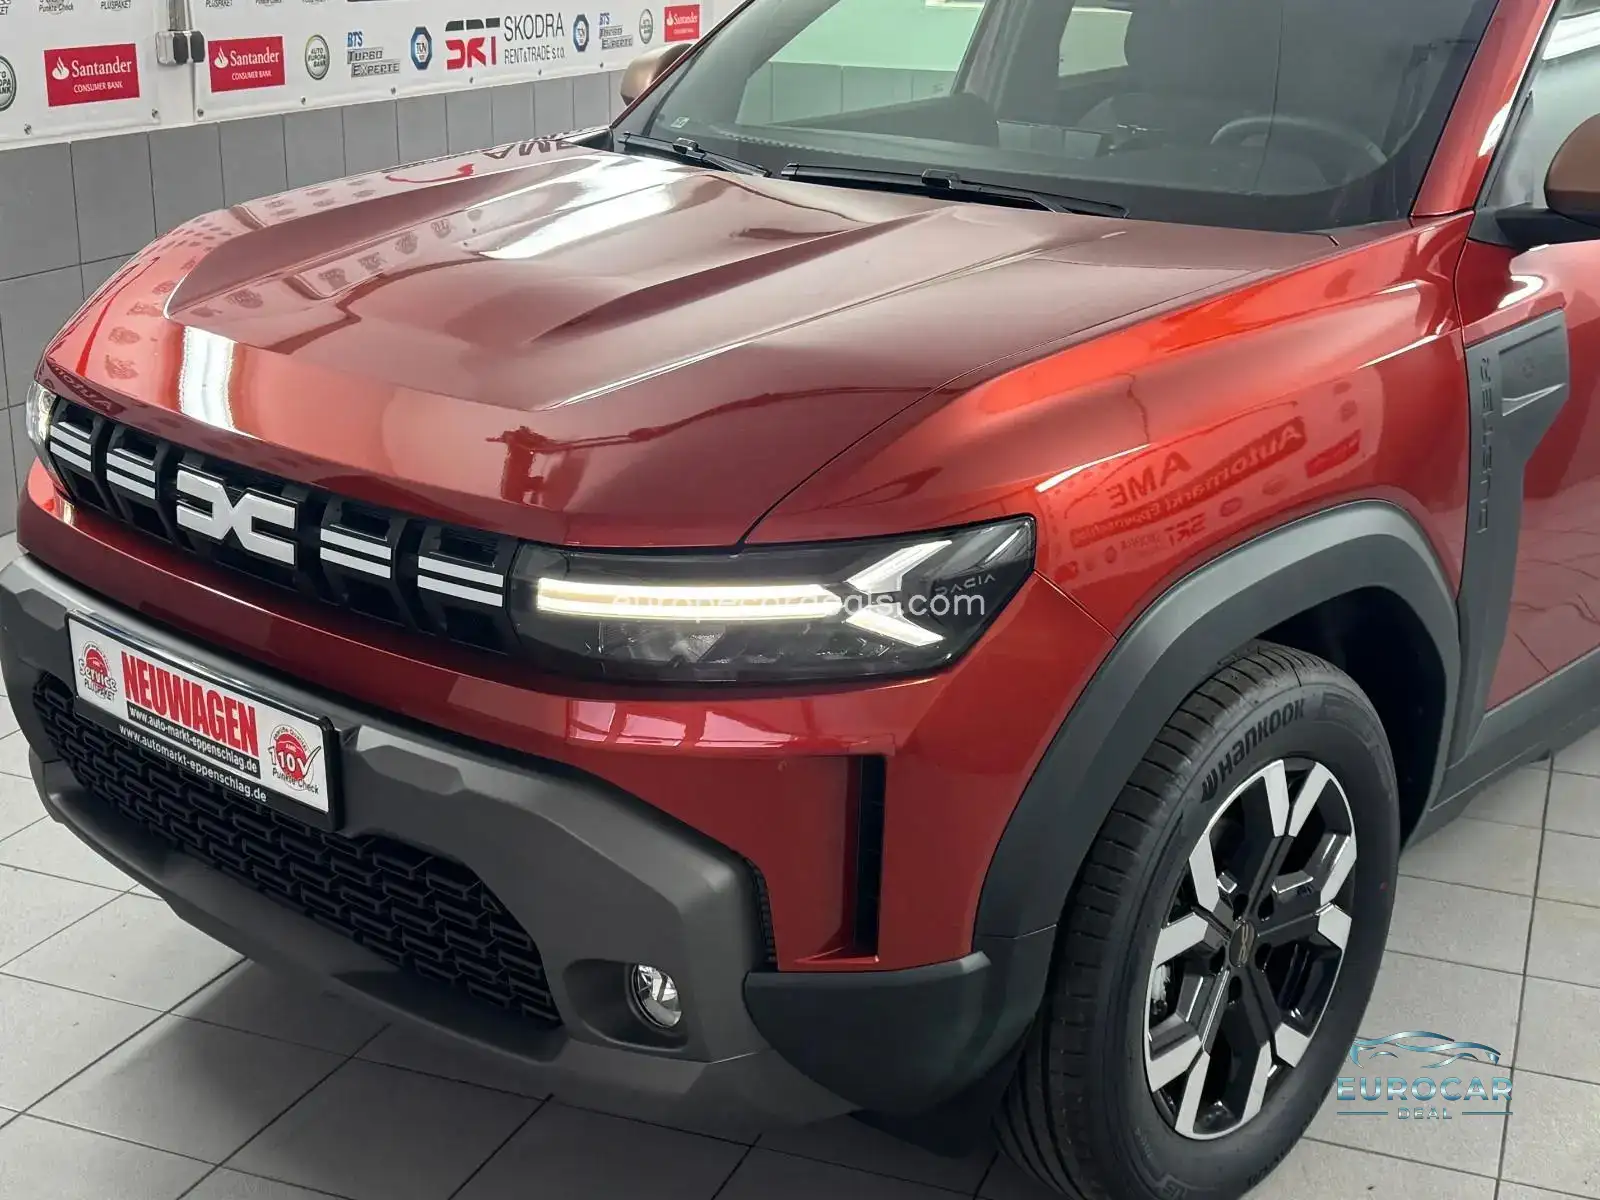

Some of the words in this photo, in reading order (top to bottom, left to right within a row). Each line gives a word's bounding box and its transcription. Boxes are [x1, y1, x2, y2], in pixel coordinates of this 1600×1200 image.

[504, 12, 564, 42] SKODRA
[347, 31, 363, 47] BTS
[72, 56, 132, 78] Santander
[230, 47, 279, 67] Santander
[74, 82, 106, 93] CONSUMER
[107, 81, 124, 90] BANK
[231, 71, 258, 81] CONSUMER
[1476, 357, 1494, 534] DUSTER
[935, 574, 996, 594] DACIA
[79, 658, 117, 692] Service
[121, 651, 260, 757] NEUWAGEN
[130, 706, 257, 773] www.auto-markt-eppenschlag.de
[119, 724, 267, 802] www.automarkt-eppenschlag.de
[298, 778, 319, 795] Check
